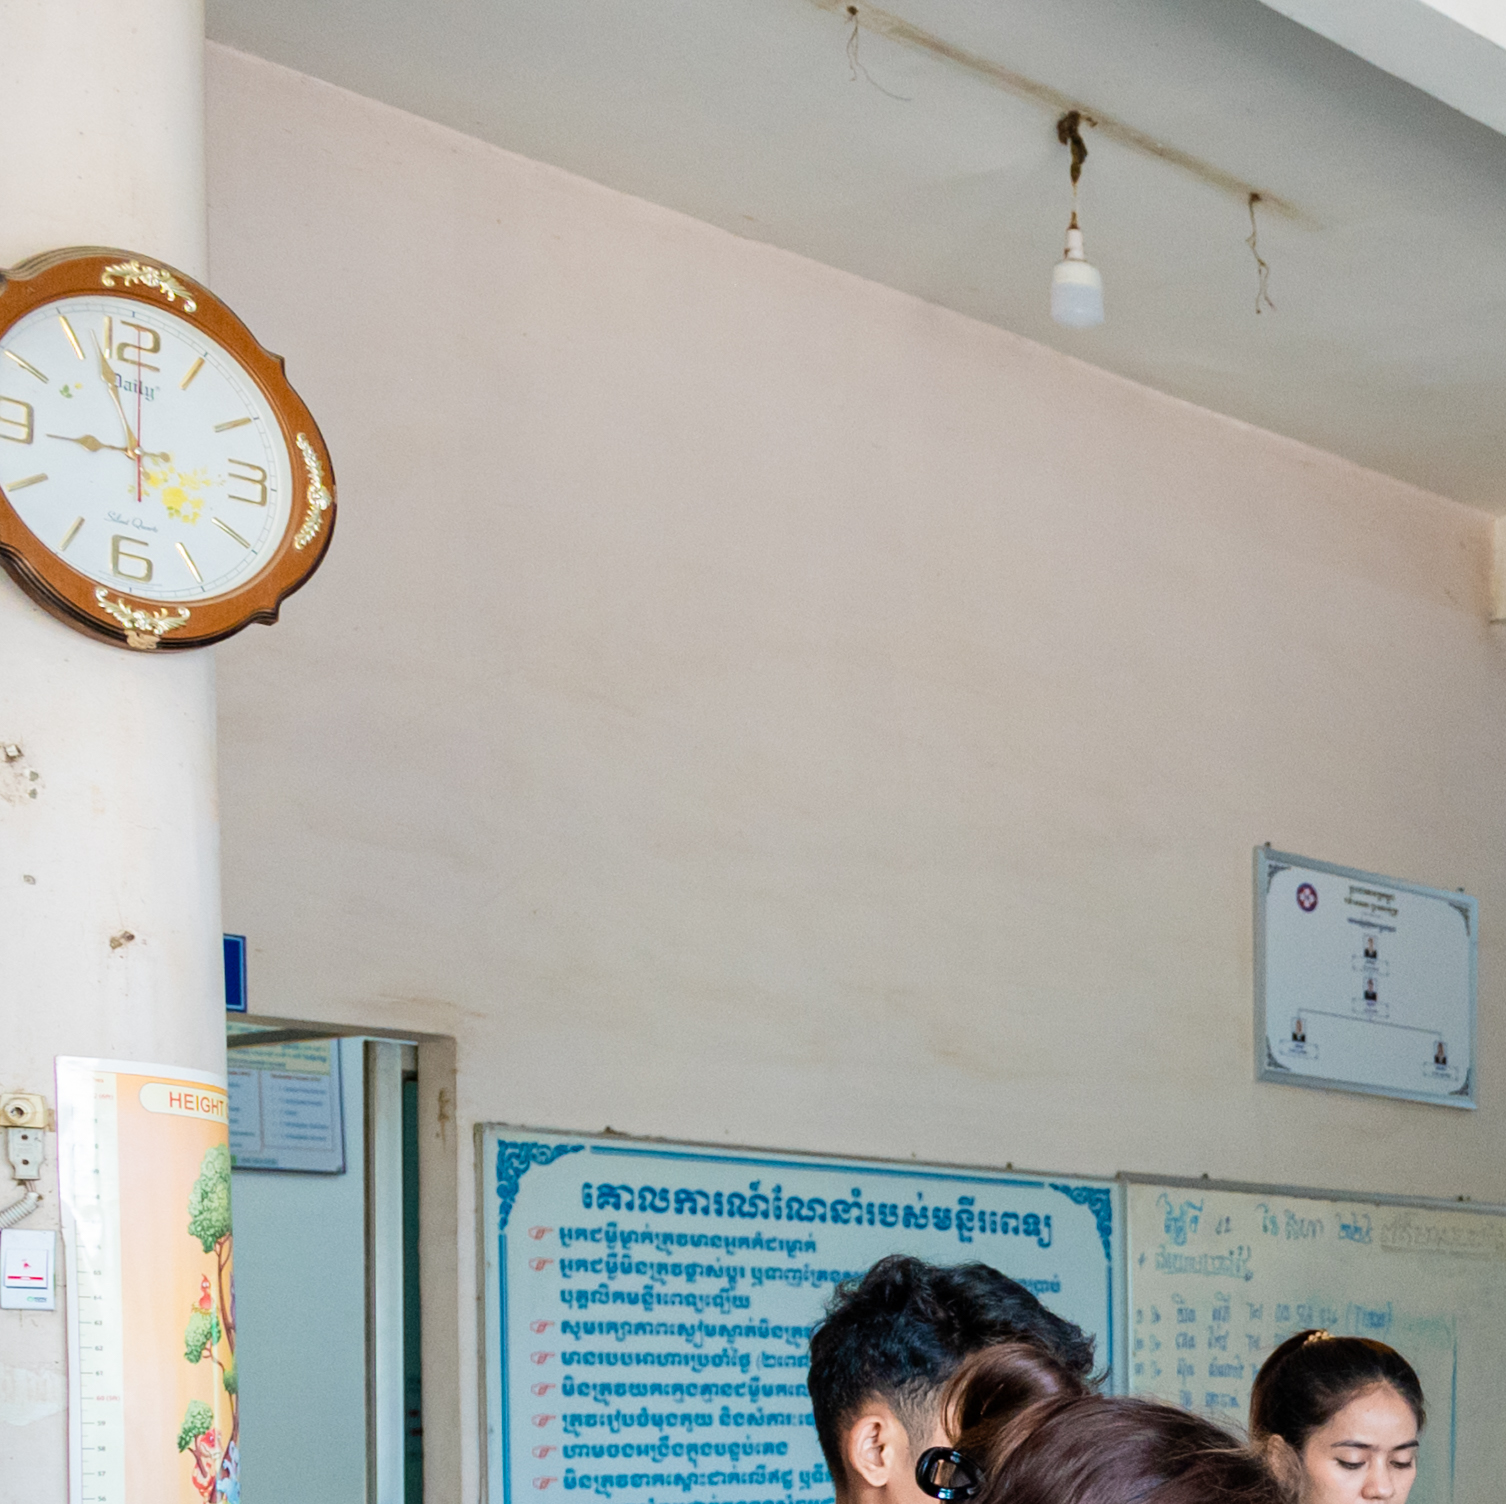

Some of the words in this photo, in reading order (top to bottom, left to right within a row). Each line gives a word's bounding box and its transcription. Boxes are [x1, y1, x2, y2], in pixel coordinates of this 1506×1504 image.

[103, 315, 161, 372] 12
[227, 457, 268, 507] 3
[110, 533, 154, 584] 6
[168, 1090, 224, 1117] HEIGHT
